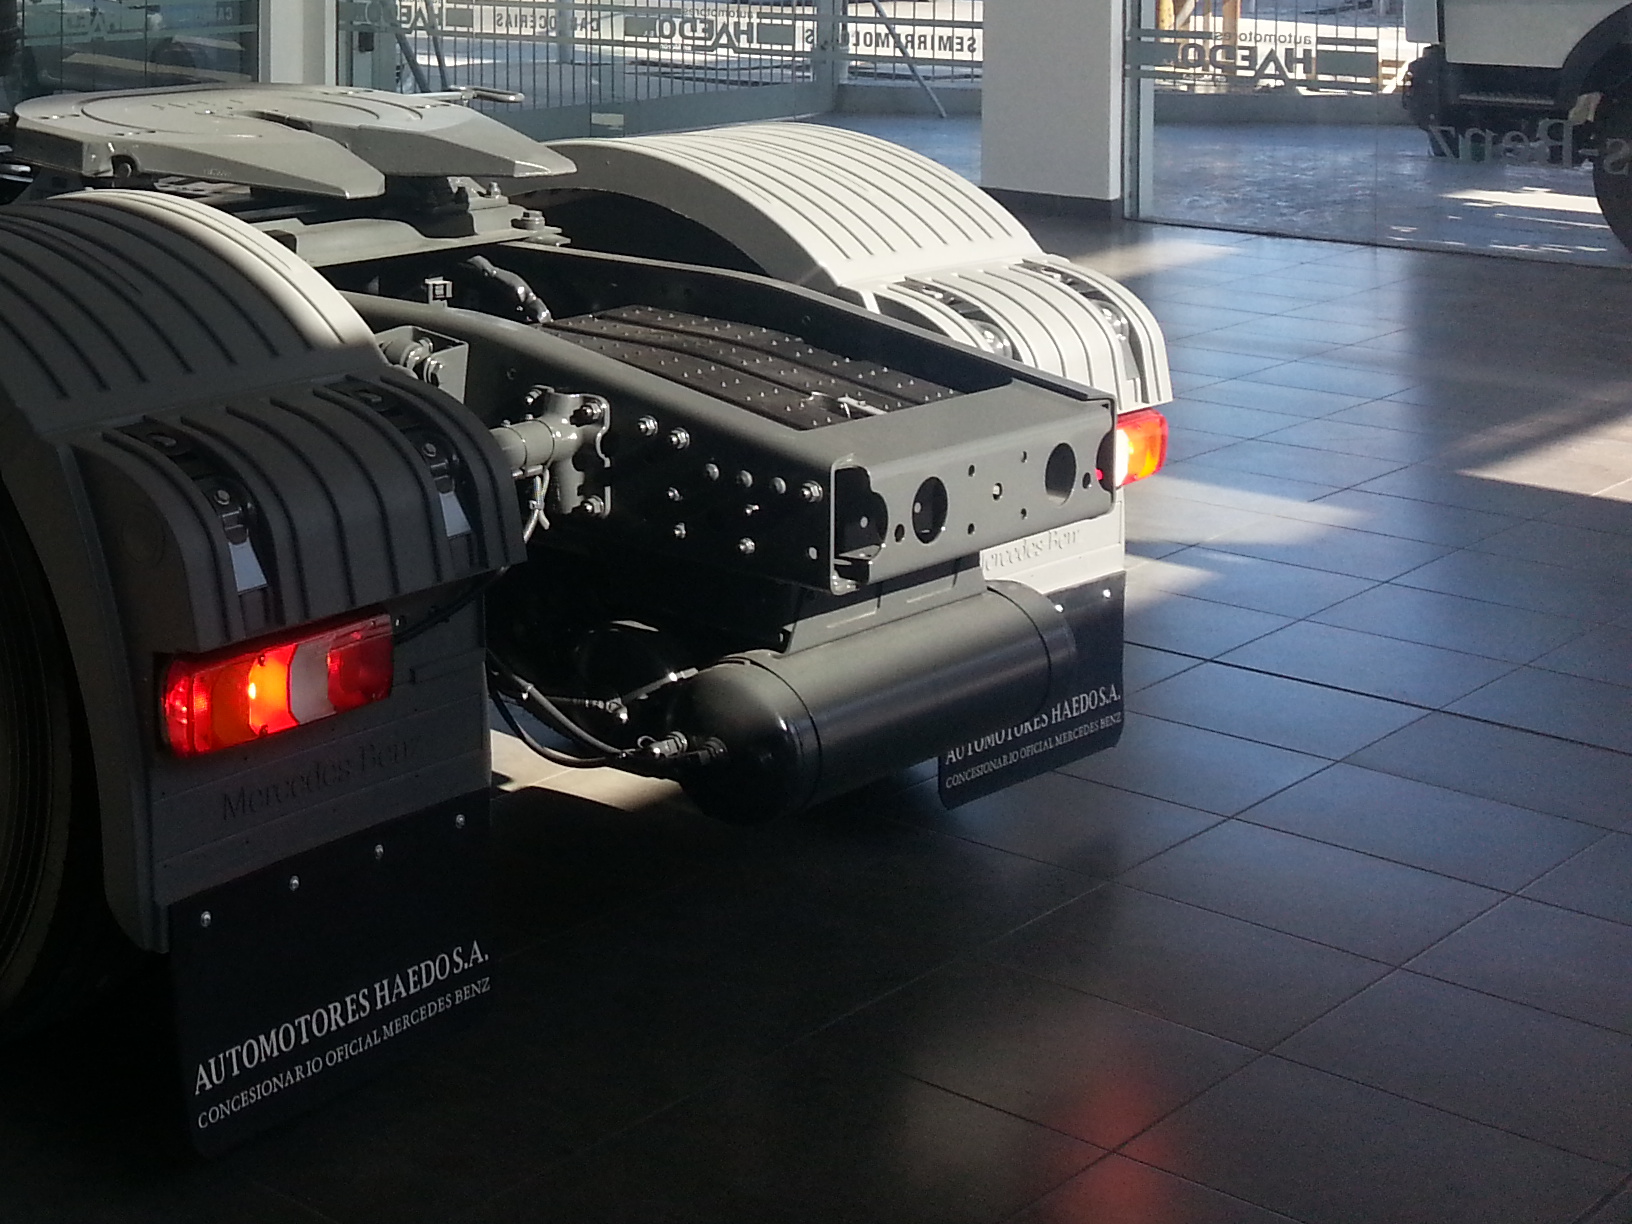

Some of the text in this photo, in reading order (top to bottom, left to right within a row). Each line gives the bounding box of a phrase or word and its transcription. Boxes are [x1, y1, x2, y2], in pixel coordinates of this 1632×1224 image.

[981, 537, 1044, 572] ercedes
[1051, 688, 1099, 725] HAEDO
[944, 710, 1123, 790] CONCESIONARIO OFICIAL MERCEDES BENZ
[194, 938, 491, 1096] AUTOMOTORES HAEDO S.A.
[197, 975, 492, 1130] CONCESIONARIO OFICIAL MERCEDES BENZ
